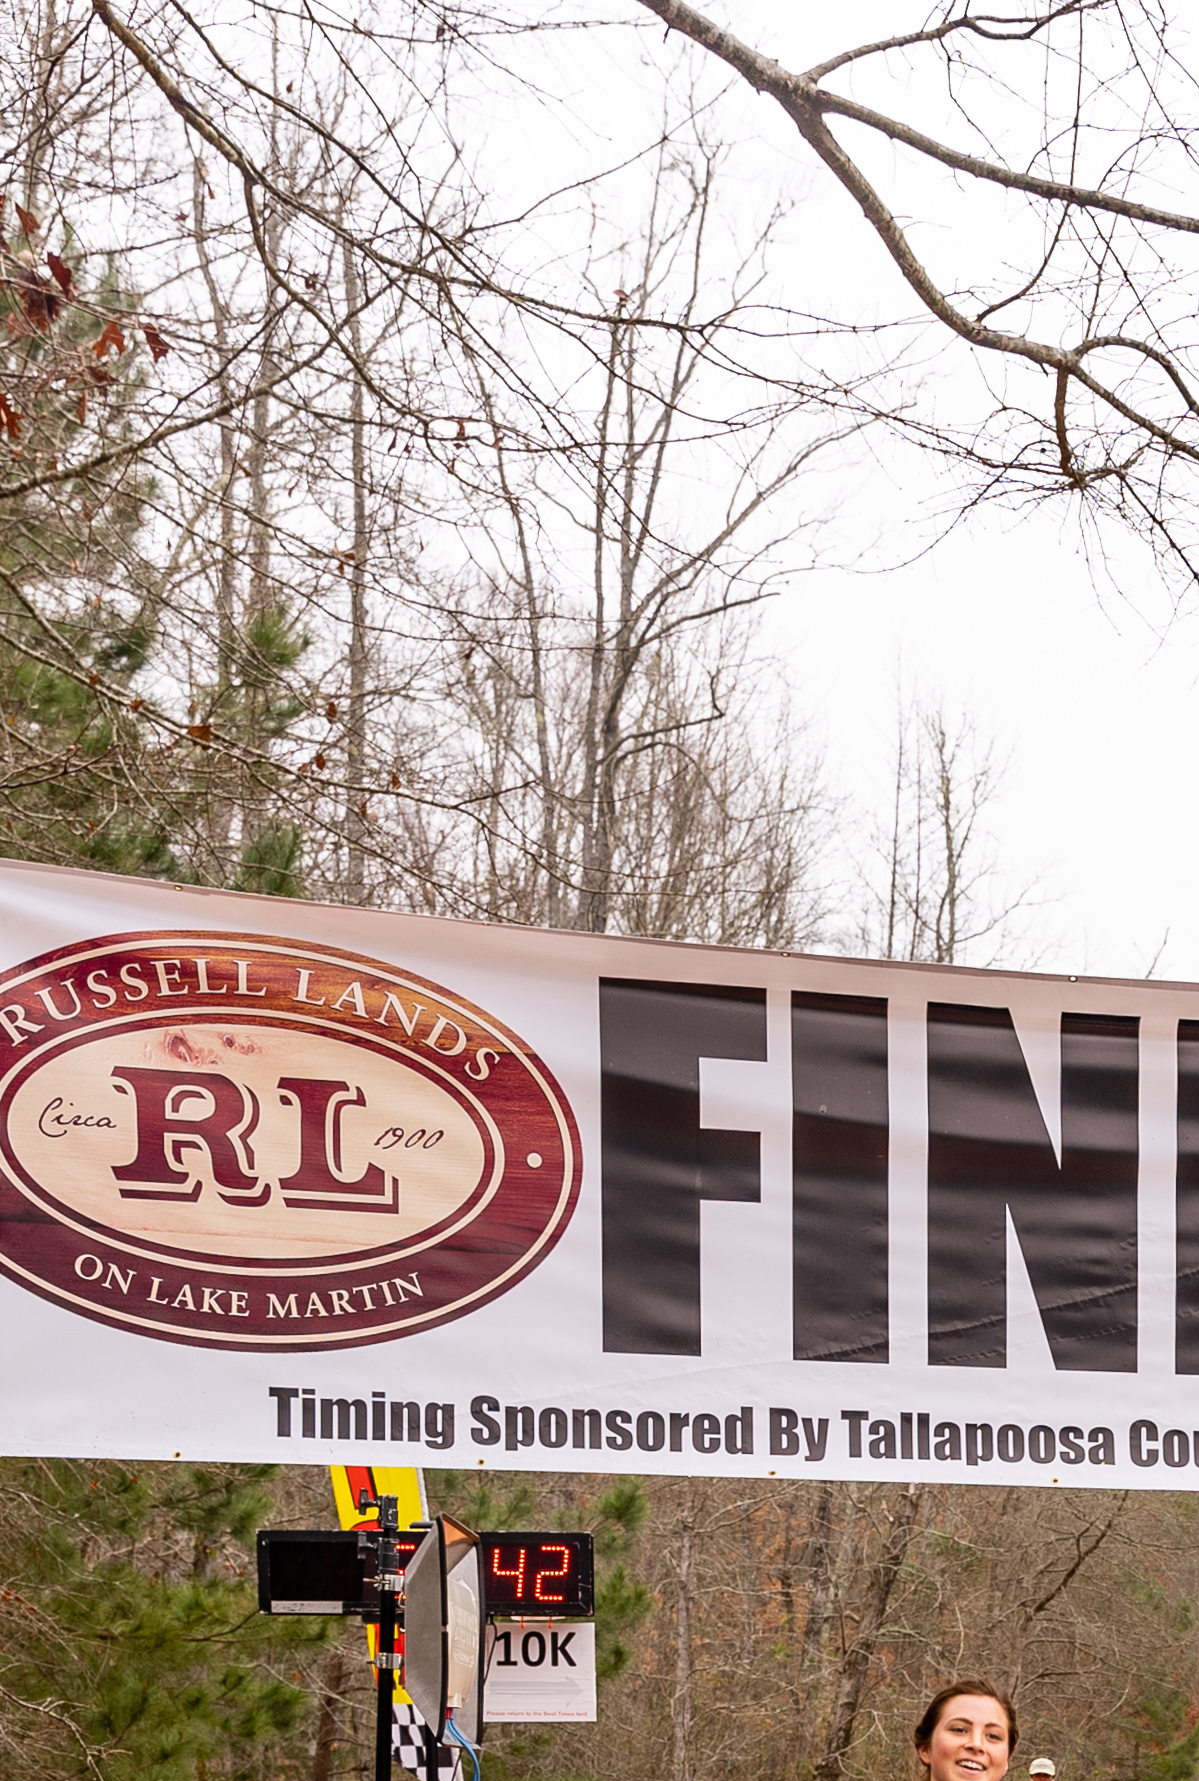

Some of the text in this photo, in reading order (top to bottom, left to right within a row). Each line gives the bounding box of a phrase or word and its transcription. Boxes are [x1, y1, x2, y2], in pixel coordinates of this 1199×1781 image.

[0, 957, 500, 1082] RUSSELL LANDS
[38, 1065, 444, 1215] Circa RL 1900
[73, 1253, 425, 1320] ON LAKE MARTIN
[268, 1386, 455, 1450] Timing
[470, 1394, 754, 1455] Sponsored
[769, 1406, 830, 1462] By
[841, 1410, 1117, 1467] Tallapoosa
[496, 1631, 577, 1667] 10K
